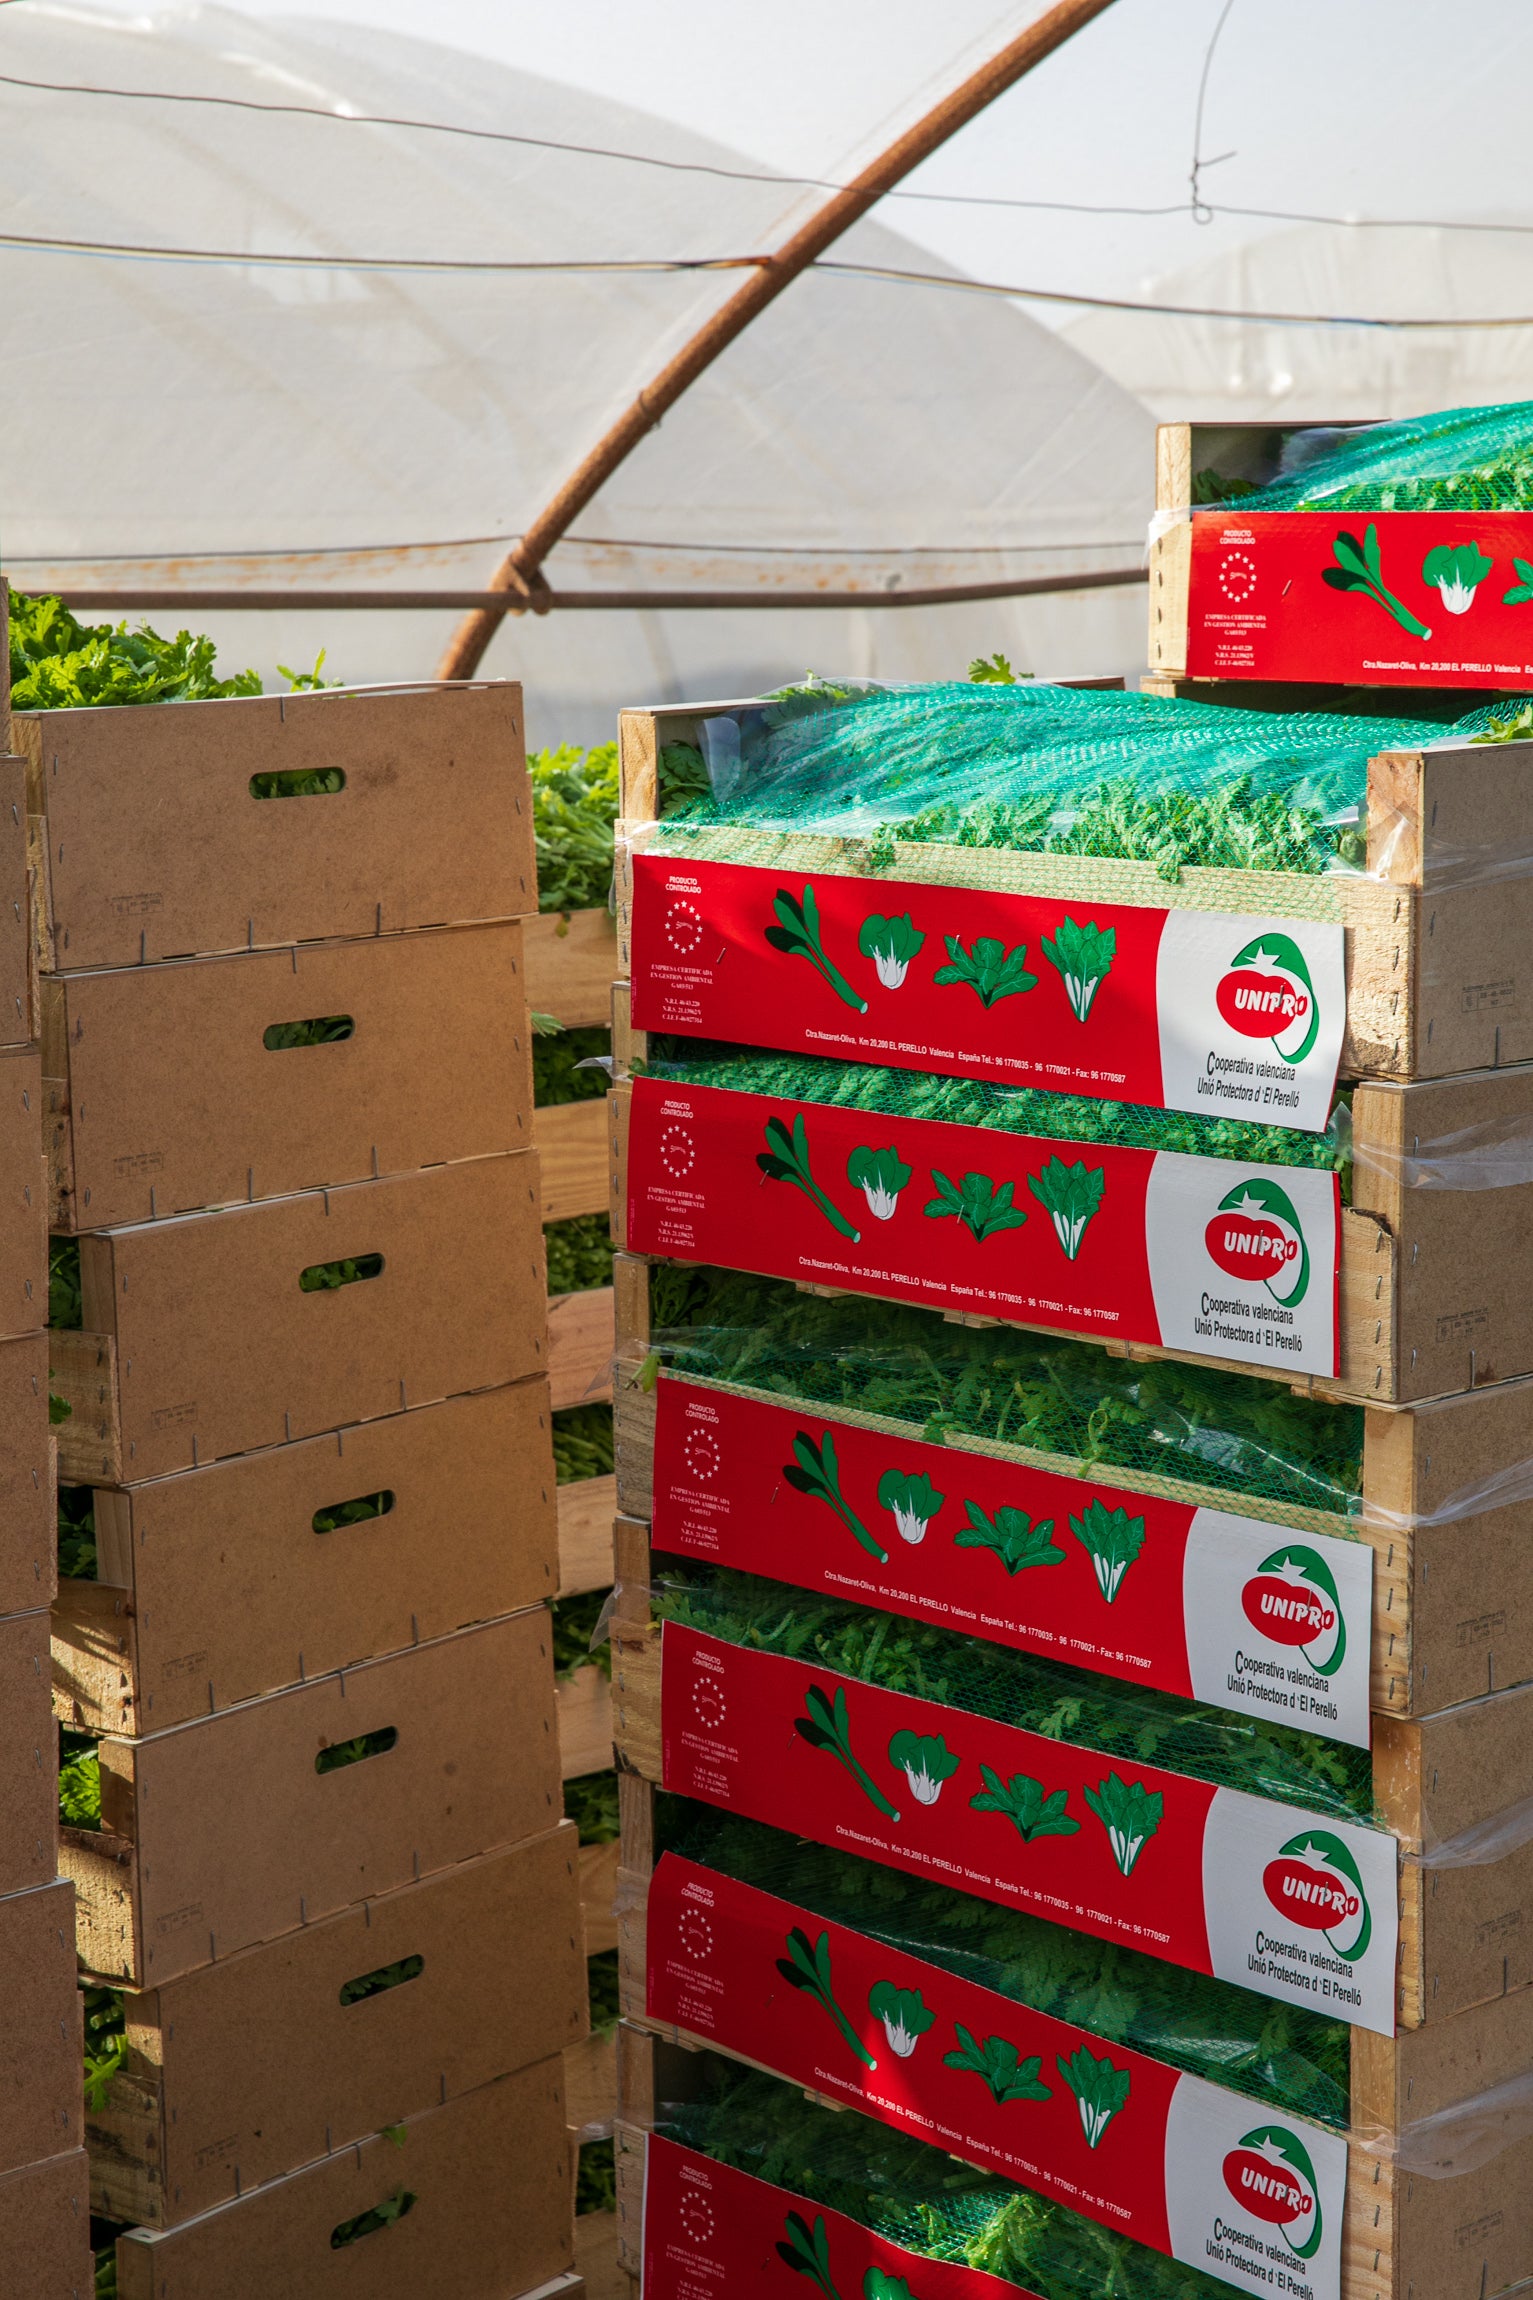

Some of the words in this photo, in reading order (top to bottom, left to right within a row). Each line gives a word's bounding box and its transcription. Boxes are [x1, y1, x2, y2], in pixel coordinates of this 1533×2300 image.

[1419, 662, 1431, 670] Km
[1450, 663, 1460, 672] EL
[1461, 663, 1492, 672] PERELLO
[1494, 664, 1521, 673] Valencia
[665, 883, 702, 894] CONTROLADO
[669, 876, 698, 886] PRODUCTO
[1235, 989, 1308, 1017] UNIPRO
[859, 1037, 869, 1046] Km
[889, 1041, 898, 1050] EL
[898, 1042, 927, 1054] PERELLO
[929, 1047, 954, 1058] Valencia
[958, 1051, 981, 1062] España
[995, 1057, 1003, 1066] 96
[1004, 1058, 1029, 1070] 1770035
[1035, 1062, 1043, 1072] 96
[1045, 1064, 1070, 1075] 1770021
[1091, 1070, 1099, 1080] 96
[1100, 1072, 1126, 1083] 1770587
[1207, 1051, 1254, 1076] Cooperativa
[1256, 1061, 1296, 1081] valenciana
[664, 1100, 690, 1110] PRODUCTO
[1197, 1077, 1214, 1096] Unió
[1215, 1080, 1254, 1101] Protectora
[1272, 1088, 1300, 1108] Perelló
[660, 1107, 694, 1119] CONTROLADO
[1224, 1231, 1297, 1262] UNIPRO
[852, 1266, 862, 1275] Km
[882, 1271, 890, 1280] EL
[891, 1273, 920, 1286] PERELLO
[922, 1279, 947, 1291] Valencia
[951, 1284, 974, 1296] España
[988, 1290, 996, 1300] 96
[997, 1292, 1022, 1304] 1770035
[1028, 1298, 1036, 1307] 96
[1038, 1300, 1064, 1311] 1770021
[1083, 1307, 1092, 1317] 96
[1093, 1309, 1120, 1321] 1770587
[1201, 1292, 1250, 1317] Cooperativa
[1252, 1303, 1293, 1324] valenciana
[1195, 1317, 1212, 1336] Unió
[1214, 1320, 1254, 1343] Protectora
[1275, 1331, 1302, 1352] Perelló
[685, 1409, 720, 1424] CONTROLADO
[689, 1403, 716, 1415] PRODUCTO
[879, 1586, 890, 1595] Km
[910, 1594, 918, 1604] EL
[919, 1597, 948, 1612] PERELLO
[951, 1606, 976, 1620] Valencia
[981, 1614, 1004, 1627] España
[1019, 1624, 1027, 1634] 96
[1028, 1627, 1053, 1641] 1770035
[1059, 1636, 1067, 1645] 96
[1070, 1639, 1095, 1653] 1770021
[1116, 1651, 1124, 1661] 96
[1125, 1654, 1152, 1668] 1770587
[1261, 1594, 1334, 1630] UNIPRO
[692, 1657, 724, 1674] CONTROLADO
[696, 1651, 721, 1665] PRODUCTO
[1235, 1650, 1284, 1680] Cooperativa
[1287, 1668, 1329, 1692] valenciana
[1227, 1674, 1246, 1694] Unió
[1247, 1680, 1288, 1706] Protectora
[1310, 1697, 1338, 1720] Perelló
[681, 1888, 714, 1907] CONTROLADO
[687, 1882, 714, 1898] PRODUCTO
[891, 1844, 902, 1854] Km
[923, 1854, 931, 1864] EL
[932, 1857, 962, 1874] PERELLO
[964, 1868, 991, 1884] Valencia
[995, 1878, 1018, 1893] España
[1034, 1891, 1042, 1901] 96
[1043, 1895, 1069, 1910] 1770035
[1075, 1905, 1084, 1915] 96
[1087, 1909, 1112, 1924] 1770021
[1133, 1924, 1142, 1934] 96
[1143, 1928, 1170, 1943] 1770587
[1282, 1876, 1359, 1915] UNIPRO
[1256, 1931, 1307, 1963] Cooperativa
[1309, 1952, 1352, 1978] valenciana
[1248, 1954, 1266, 1975] Unió
[1268, 1960, 1310, 1990] Protectora
[1333, 1982, 1362, 2006] Perelló
[867, 2091, 877, 2102] Km
[896, 2105, 904, 2116] EL
[905, 2109, 934, 2128] PERELLO
[936, 2123, 962, 2141] Valencia
[966, 2136, 990, 2152] España
[1005, 2153, 1012, 2162] 96
[1014, 2157, 1038, 2174] 1770035
[1043, 2171, 1051, 2181] 96
[1054, 2177, 1077, 2194] 1770021
[1097, 2197, 1105, 2208] 96
[1106, 2202, 1132, 2220] 1770587
[1241, 2167, 1312, 2214] UNIPRO
[1214, 2217, 1264, 2254] Cooperativa
[1266, 2245, 1306, 2275] valenciana
[1206, 2239, 1224, 2261] Unió
[1226, 2248, 1266, 2280] Protectora
[1287, 2276, 1314, 2300] Perelló
